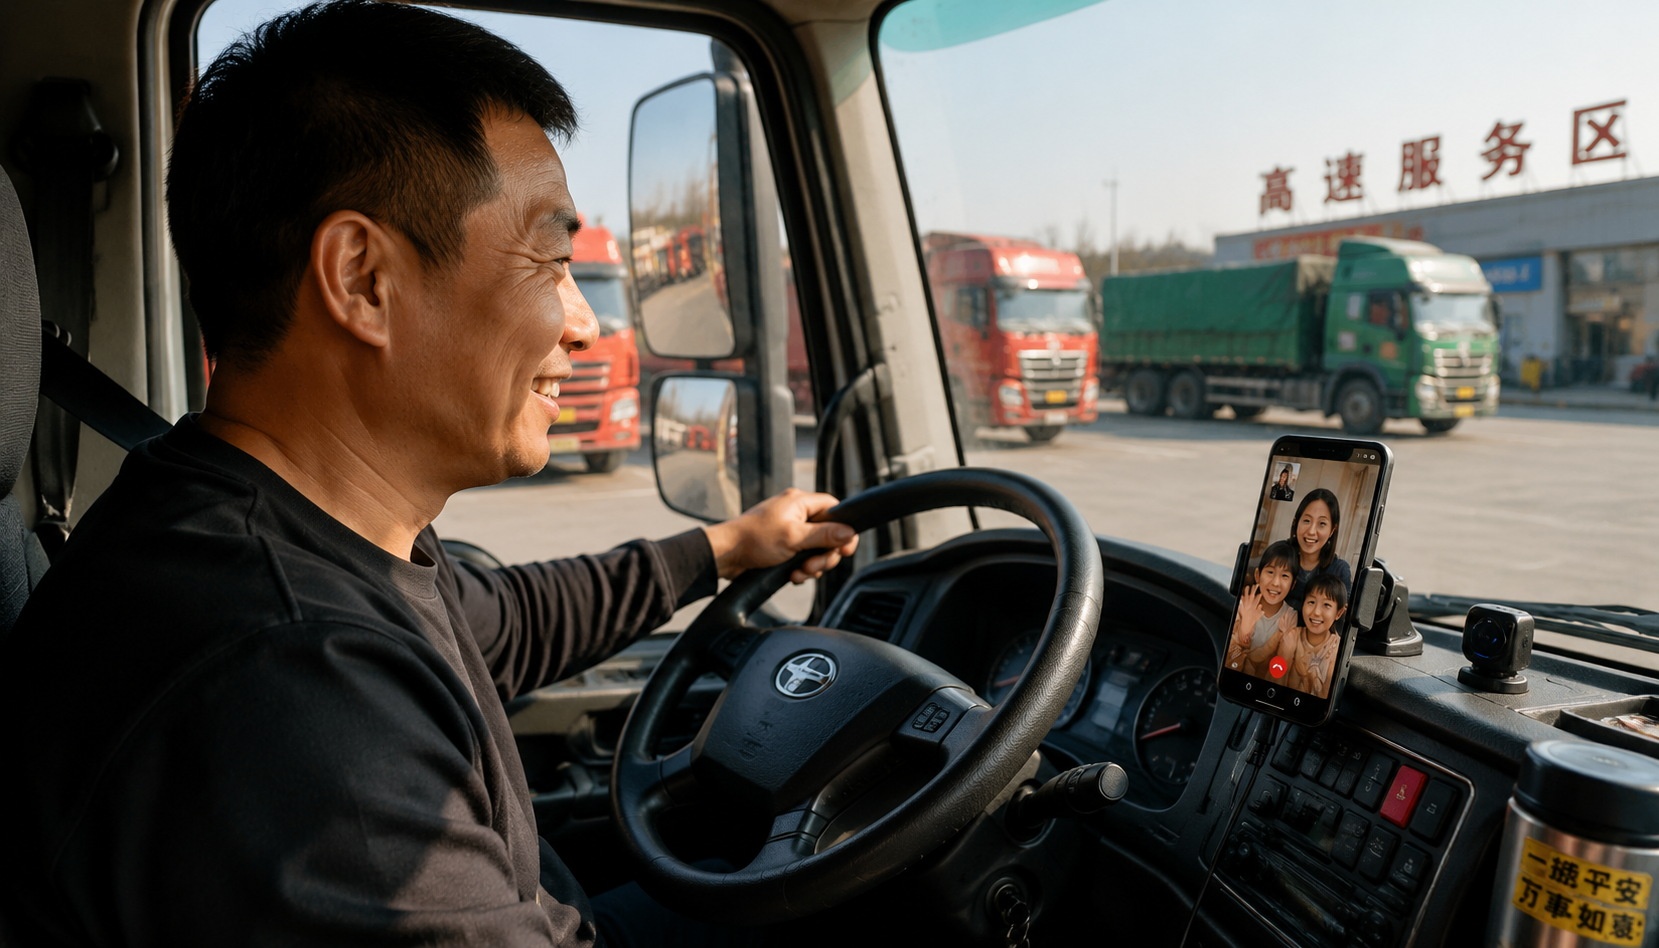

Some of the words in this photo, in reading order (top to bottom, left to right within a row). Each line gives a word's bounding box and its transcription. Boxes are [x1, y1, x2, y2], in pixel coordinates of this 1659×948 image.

[1260, 98, 1628, 217] 高速服务区
